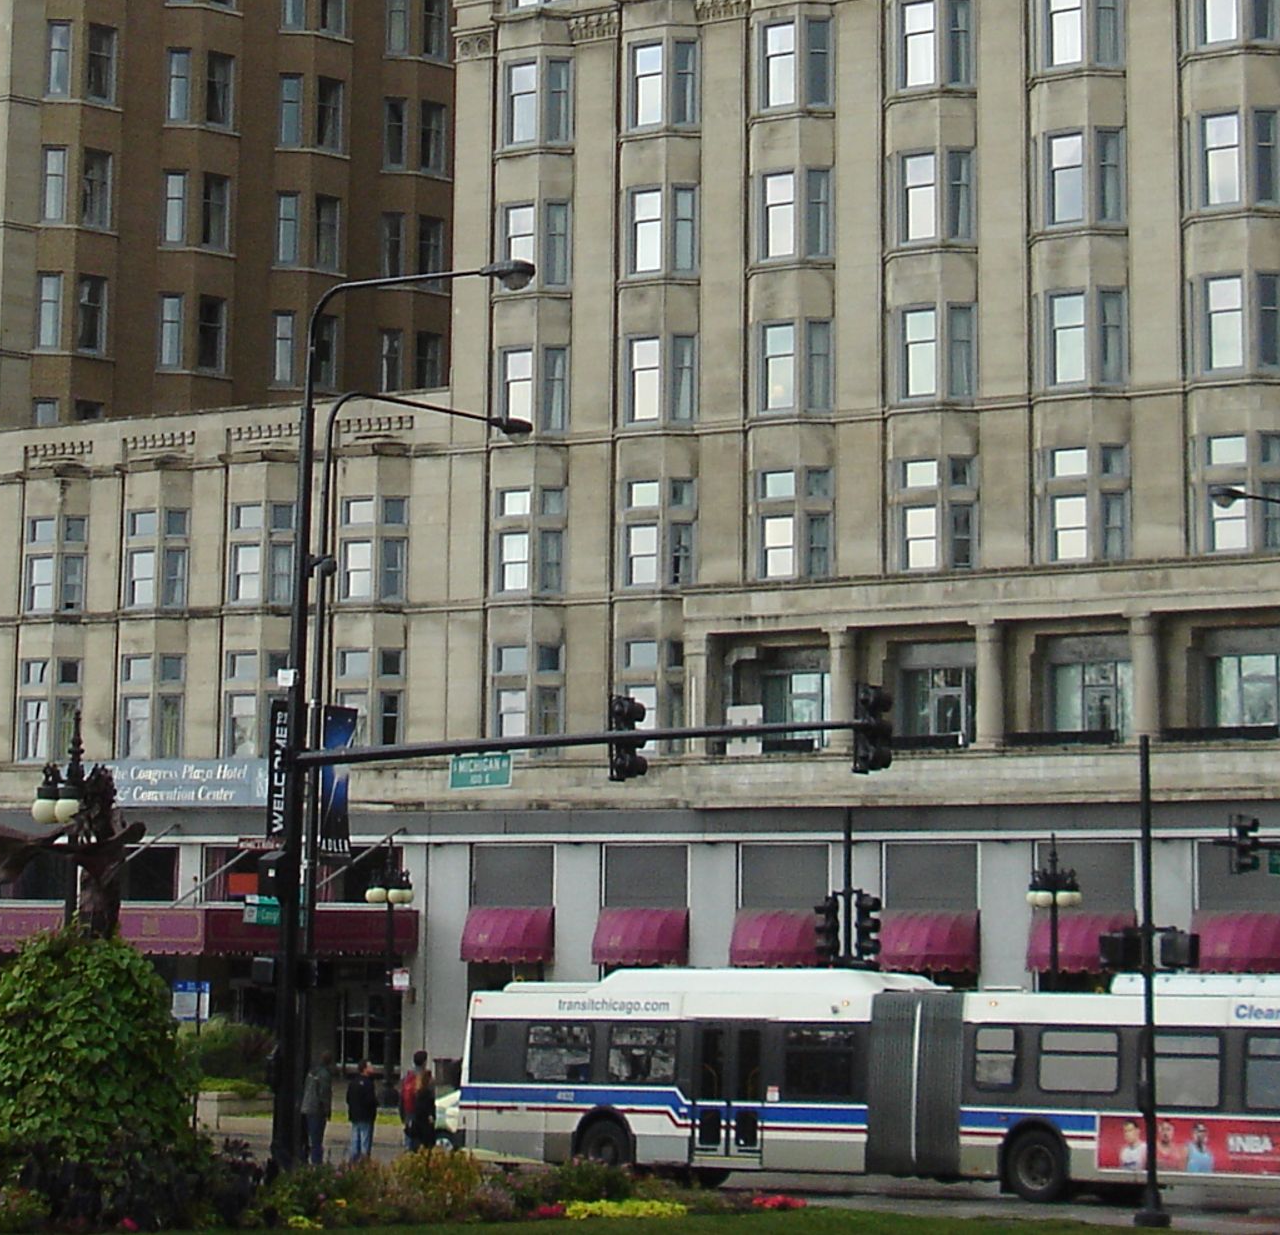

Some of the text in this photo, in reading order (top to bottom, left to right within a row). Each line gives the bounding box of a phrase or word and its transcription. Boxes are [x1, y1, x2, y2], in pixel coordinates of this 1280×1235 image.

[458, 757, 500, 773] MICHIGAN
[130, 765, 178, 784] Congress
[182, 764, 213, 782] Plaza
[216, 764, 248, 781] Hotel
[132, 785, 195, 802] Convention
[197, 785, 236, 801] Center
[321, 837, 350, 853] ADLER
[558, 998, 670, 1014] transitchicago.com
[1236, 1134, 1273, 1154] NBA
